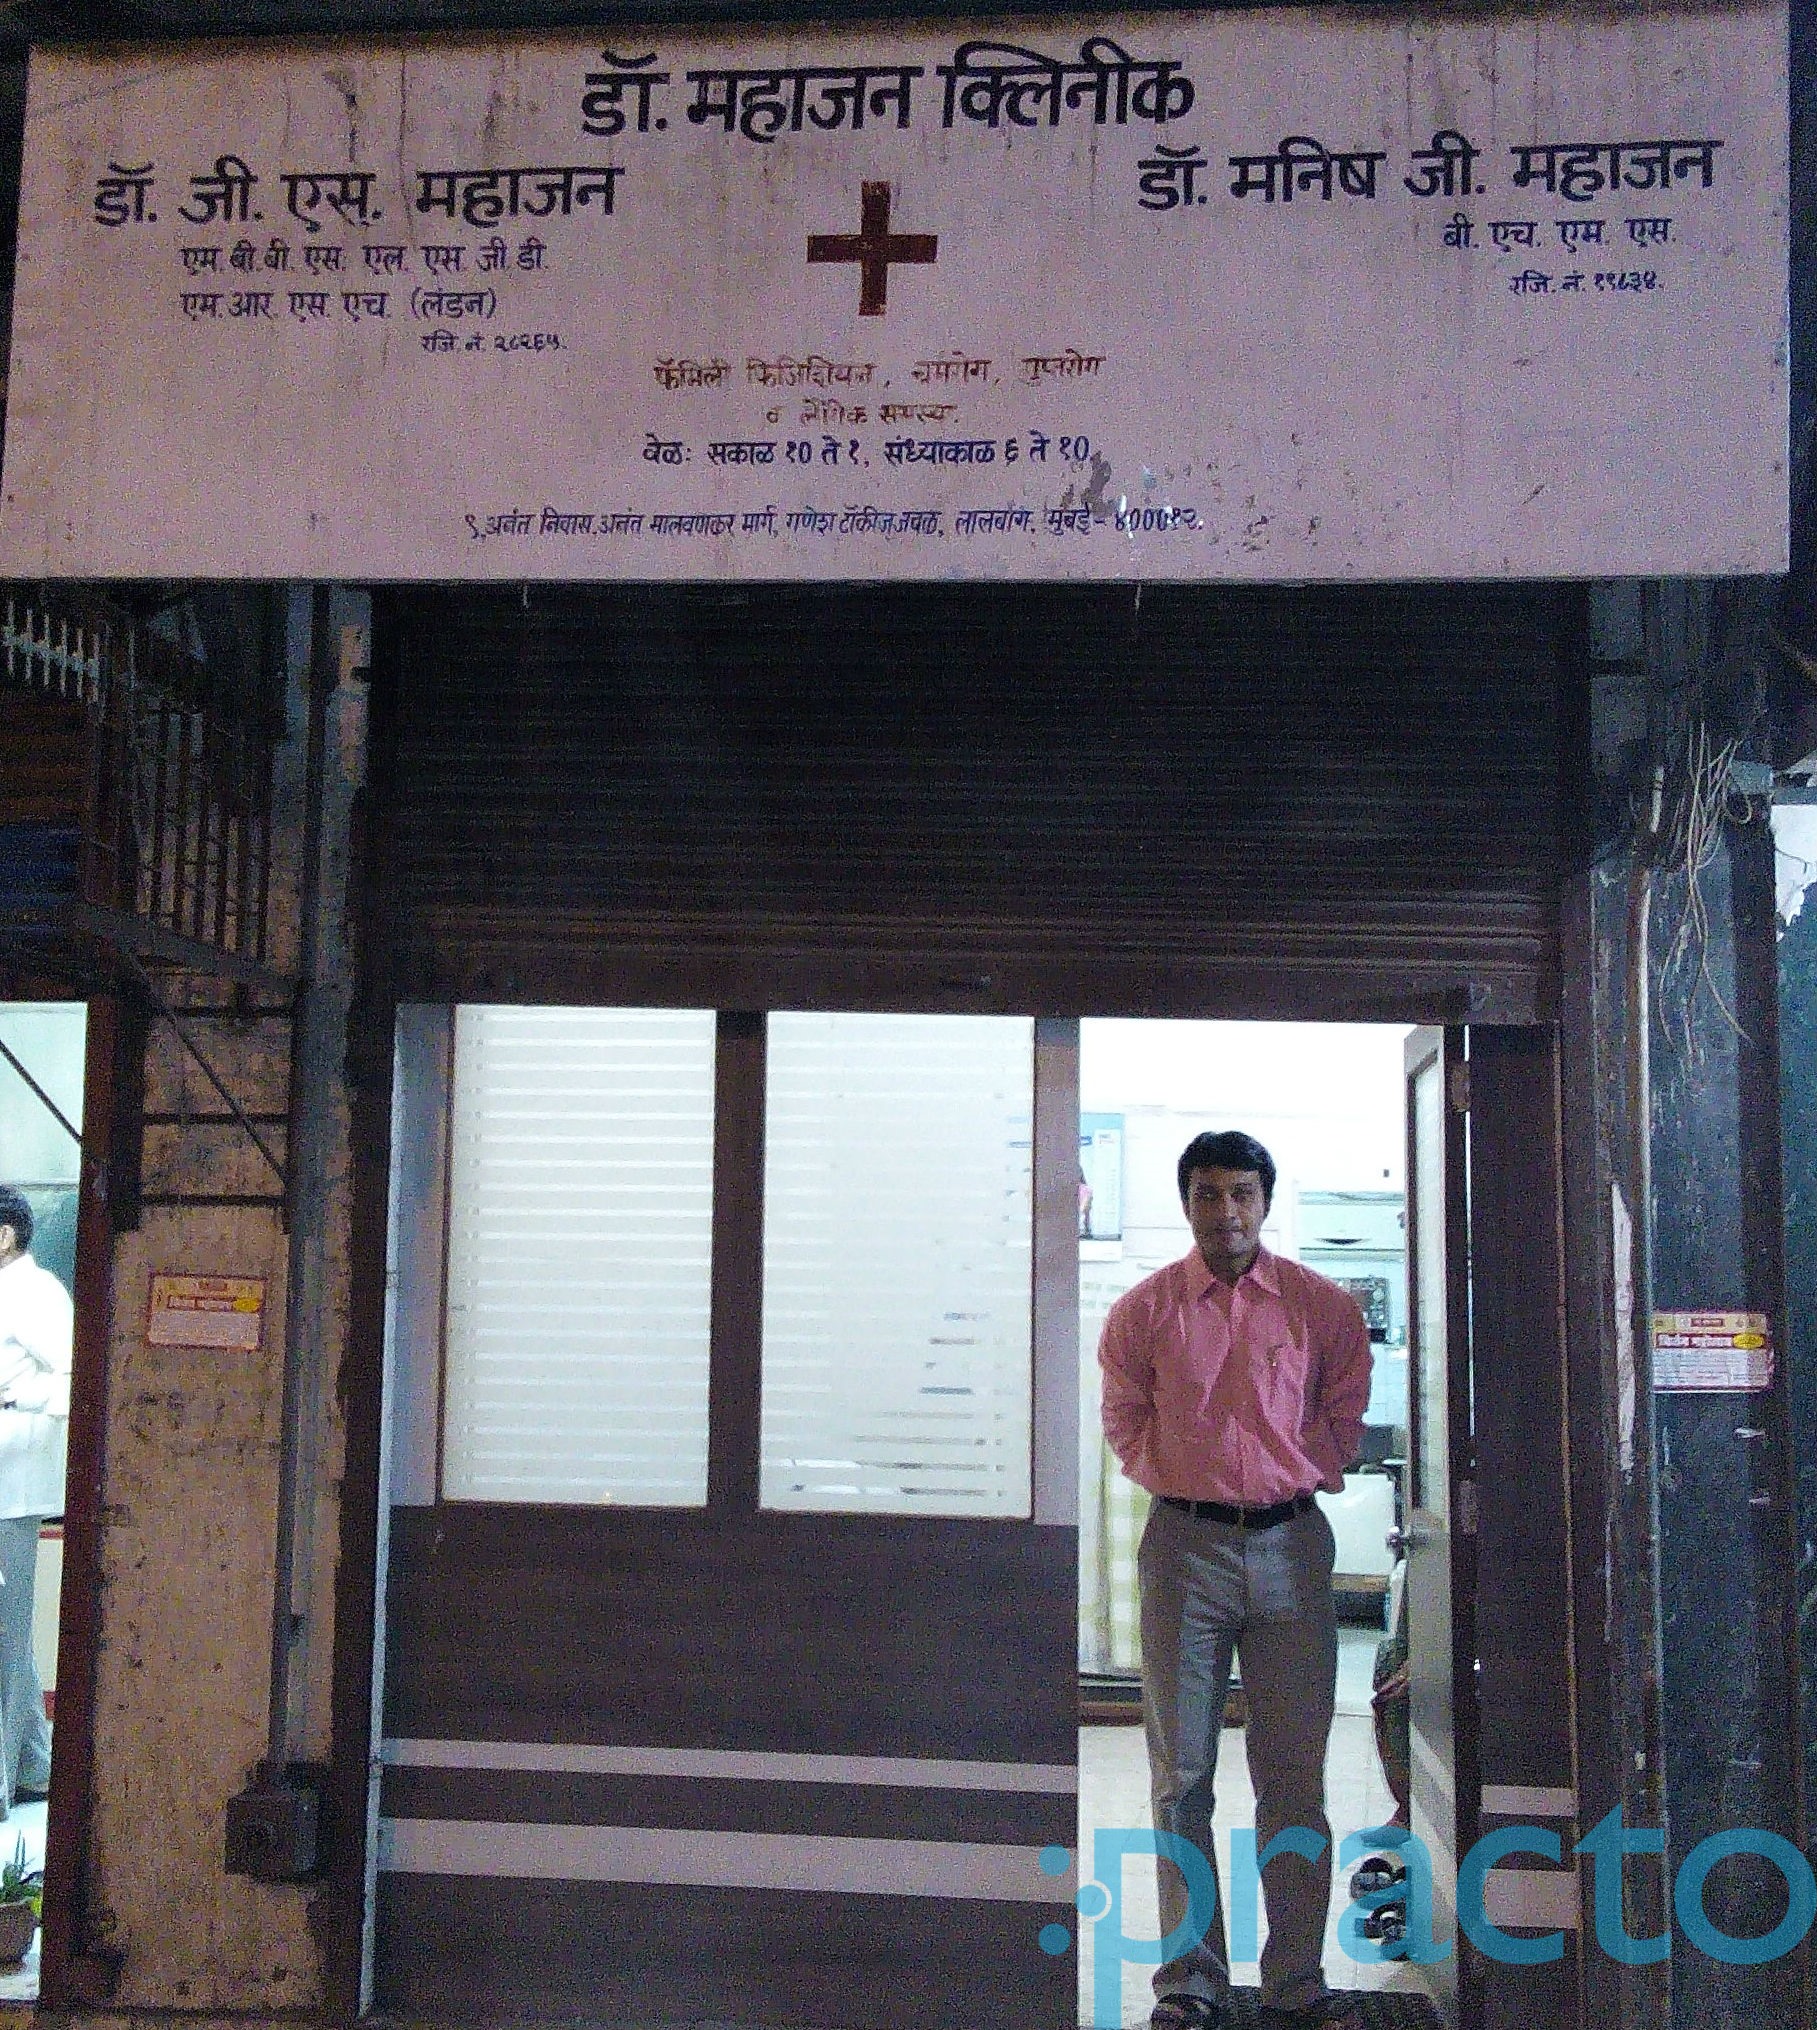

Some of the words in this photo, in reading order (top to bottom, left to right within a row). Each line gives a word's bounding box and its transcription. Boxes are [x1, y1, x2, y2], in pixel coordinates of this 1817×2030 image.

[581, 49, 670, 137] डॉ.
[686, 66, 924, 144] महाजन
[935, 36, 1196, 129] क्लिनीक
[93, 161, 158, 227] डॉ.
[178, 153, 263, 222] जी.
[415, 165, 626, 228] महाजन
[1136, 144, 1208, 211] डॉ.
[1228, 136, 1387, 204] मनिष
[1403, 130, 1486, 197] जी.
[1510, 139, 1726, 201] महाजन
[707, 441, 778, 465] सकाळ
[884, 435, 996, 467] संध्याकाळ
